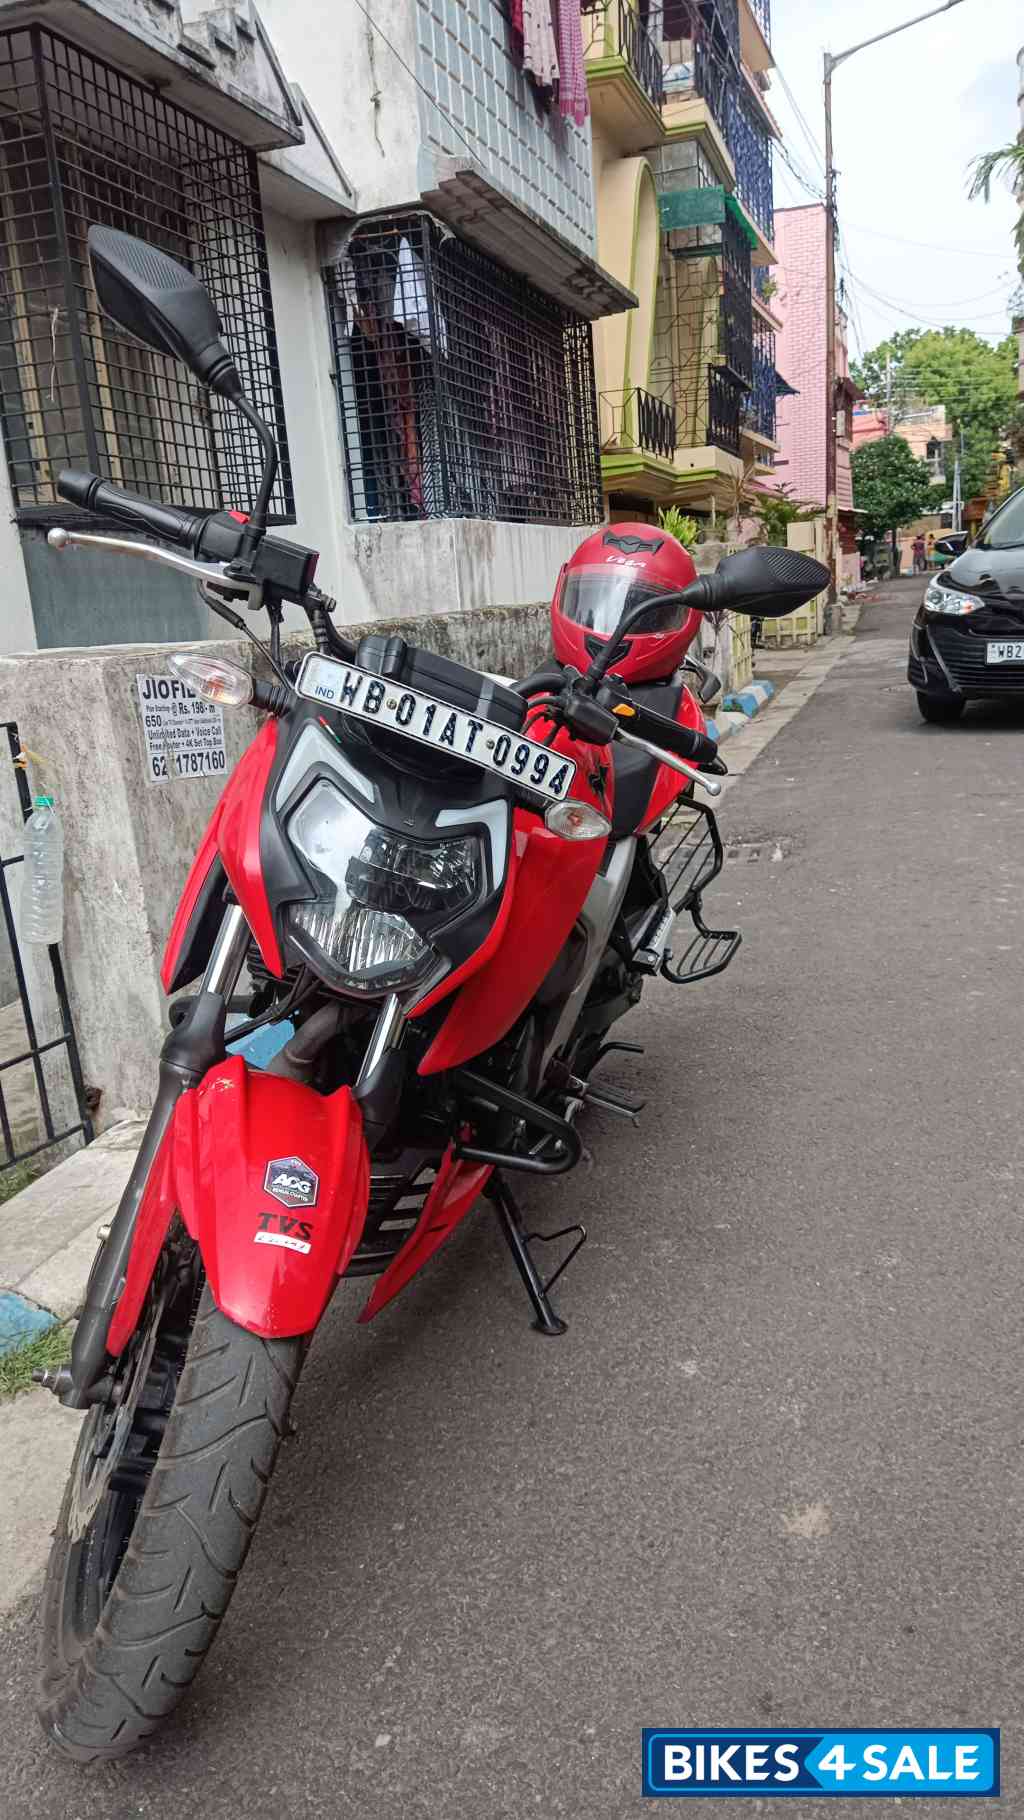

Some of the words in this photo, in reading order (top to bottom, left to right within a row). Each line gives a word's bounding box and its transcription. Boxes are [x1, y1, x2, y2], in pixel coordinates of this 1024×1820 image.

[314, 685, 335, 700] IND
[145, 715, 162, 727] 650
[256, 1212, 314, 1241] TVS
